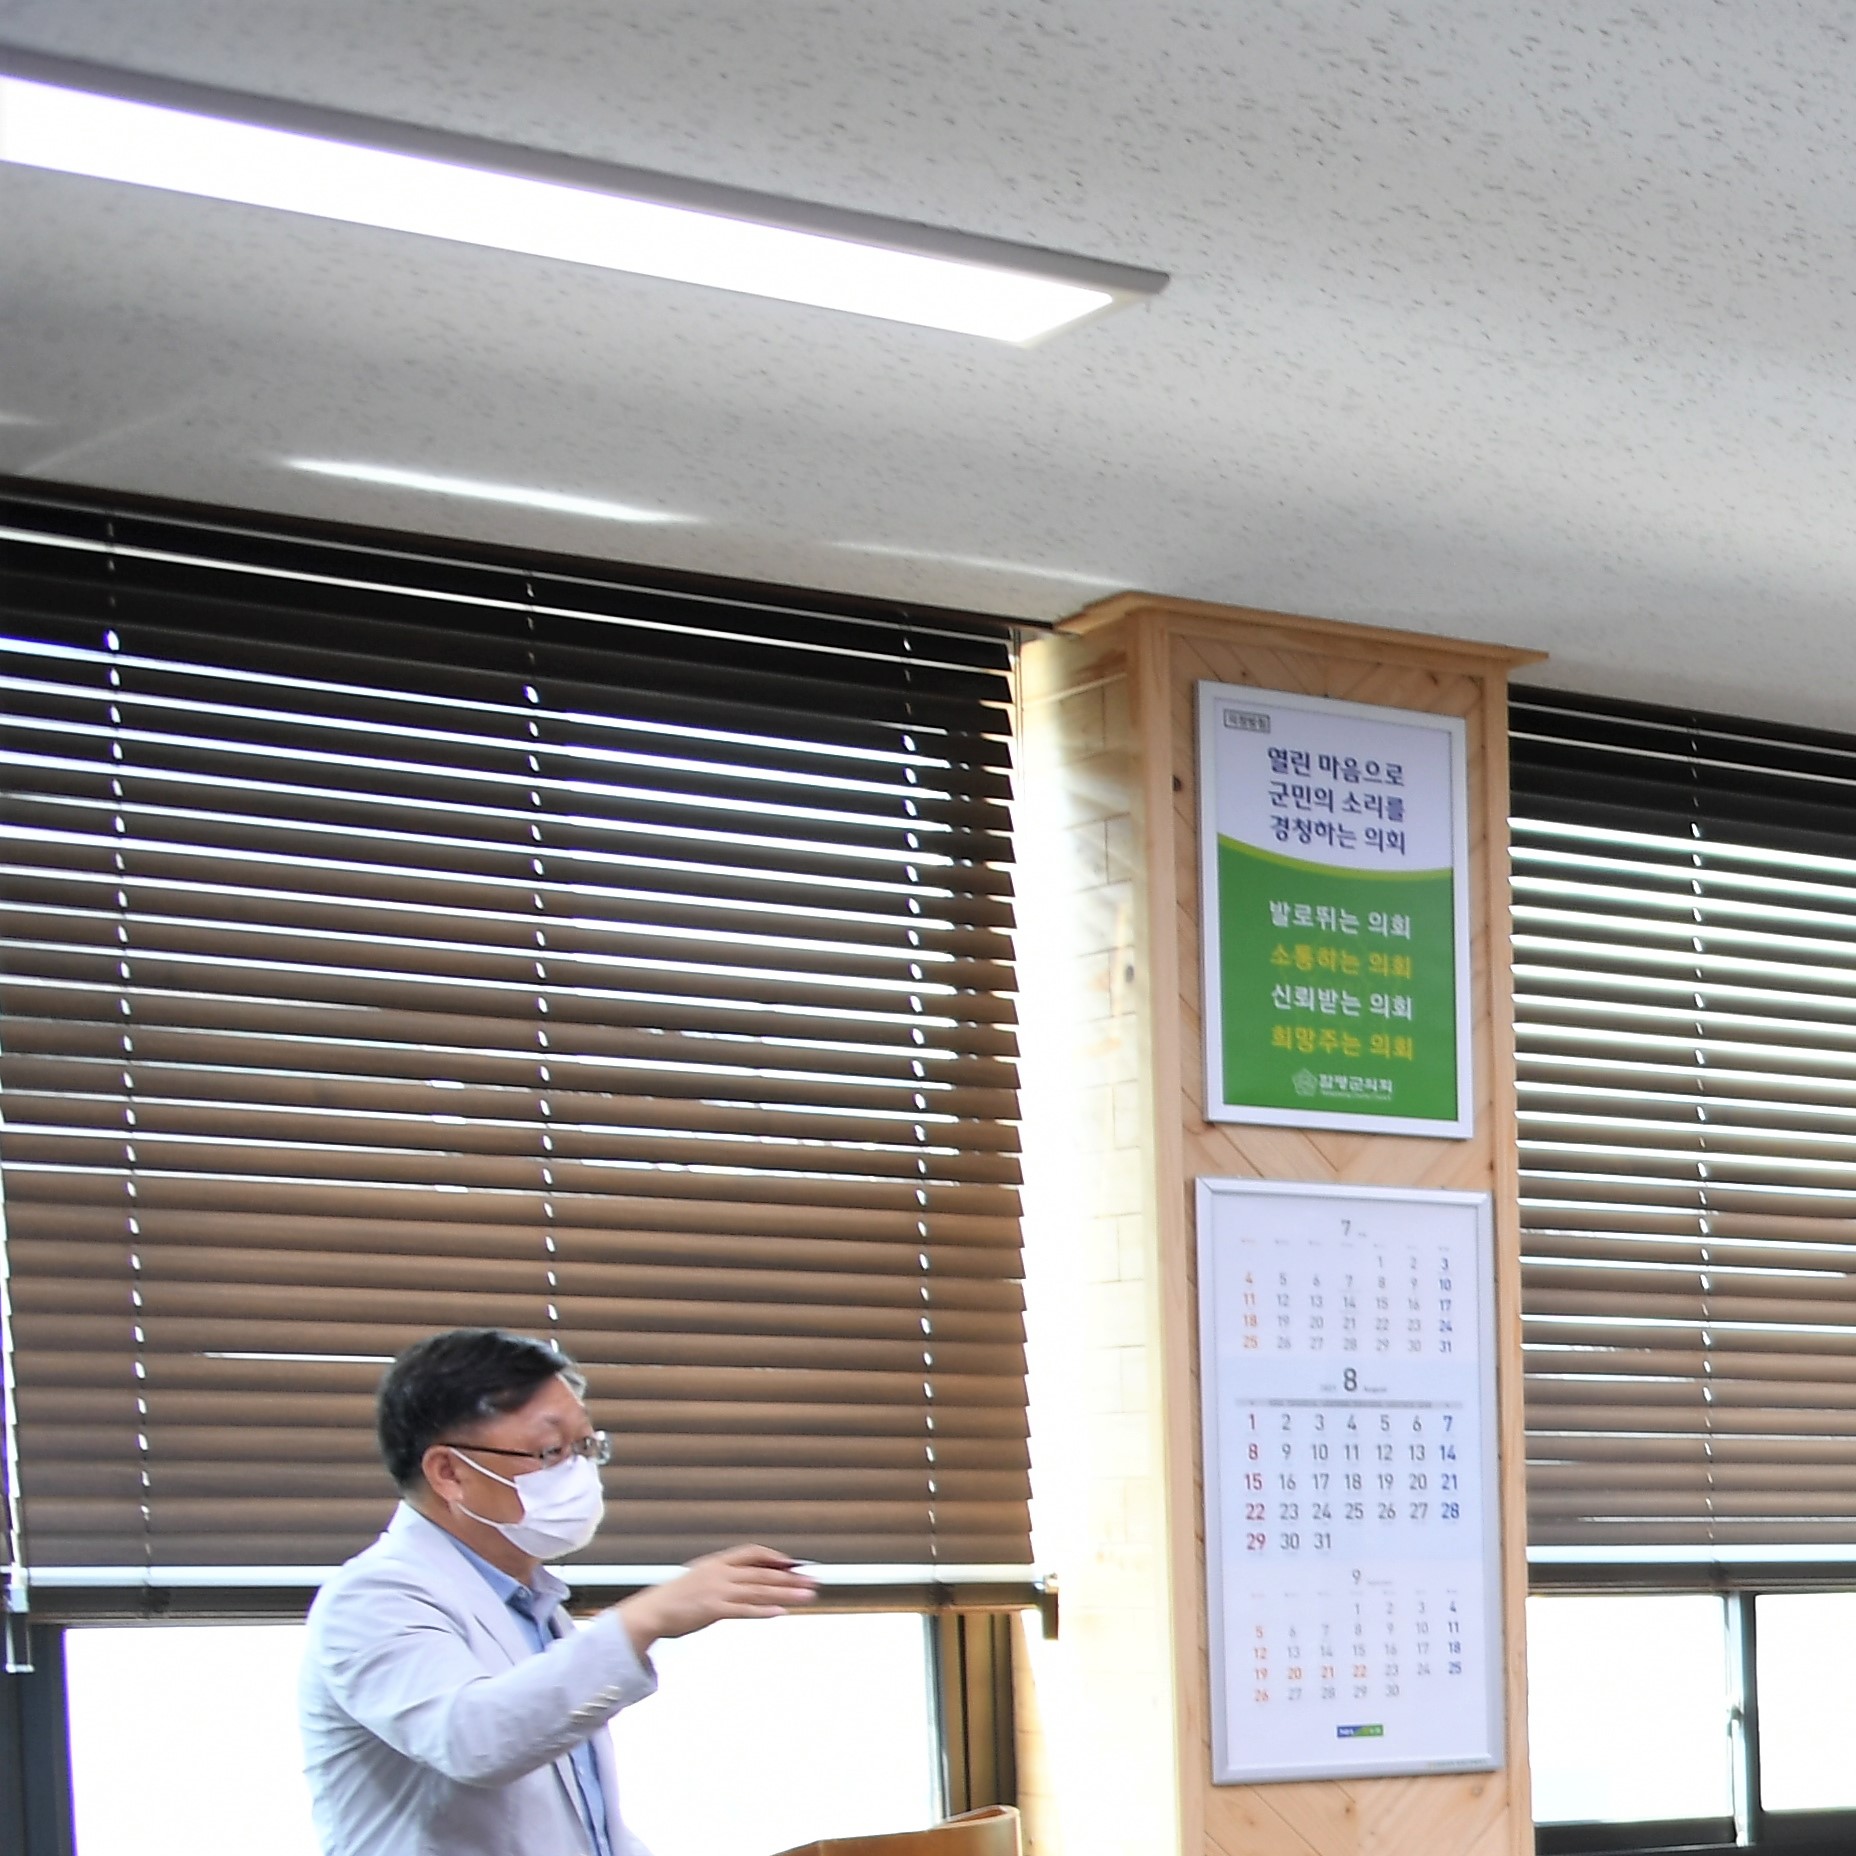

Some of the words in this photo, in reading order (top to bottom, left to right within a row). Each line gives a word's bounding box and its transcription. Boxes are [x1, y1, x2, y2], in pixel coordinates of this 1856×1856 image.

[1267, 746, 1312, 776] 열린
[1318, 753, 1405, 787] 마음으로
[1268, 780, 1334, 813] 군민의
[1343, 787, 1405, 822] 소리를
[1271, 815, 1358, 850] 경청하는
[1364, 825, 1406, 855] 의회
[1269, 900, 1359, 935] 발로뛰는
[1368, 910, 1411, 940] 의회
[1271, 943, 1360, 976] 소통하는
[1369, 951, 1412, 980] 의회
[1271, 984, 1362, 1016] 신뢰받는
[1370, 993, 1413, 1021] 의회
[1271, 1024, 1362, 1058] 희망주는
[1371, 1033, 1414, 1061] 의회
[1343, 1367, 1358, 1393] 8
[1248, 1413, 1256, 1431] 1
[1281, 1412, 1292, 1432] 2
[1314, 1413, 1325, 1432] 3
[1346, 1414, 1358, 1431] 4
[1379, 1413, 1391, 1433] 5
[1412, 1415, 1423, 1433] 6
[1442, 1414, 1454, 1433] 7
[1248, 1442, 1259, 1461] 8
[1281, 1442, 1292, 1461] 9
[1311, 1442, 1329, 1461] 10
[1344, 1443, 1360, 1461] 11
[1376, 1443, 1394, 1462] 12
[1408, 1443, 1426, 1462] 13
[1439, 1444, 1457, 1461] 14
[1244, 1472, 1263, 1491] 15
[1278, 1472, 1297, 1491] 16
[1312, 1472, 1330, 1491] 17
[1344, 1472, 1363, 1491] 18
[1377, 1472, 1394, 1491] 19
[1408, 1472, 1428, 1491] 20
[1441, 1472, 1458, 1491] 21
[1245, 1502, 1266, 1521] 22
[1279, 1502, 1300, 1521] 23
[1312, 1502, 1333, 1521] 24
[1344, 1502, 1364, 1521] 25
[1377, 1502, 1397, 1521] 26
[1409, 1501, 1429, 1520] 27
[1441, 1502, 1460, 1520] 28
[1246, 1532, 1267, 1551] 29
[1279, 1532, 1300, 1551] 30
[1313, 1531, 1332, 1550] 31
